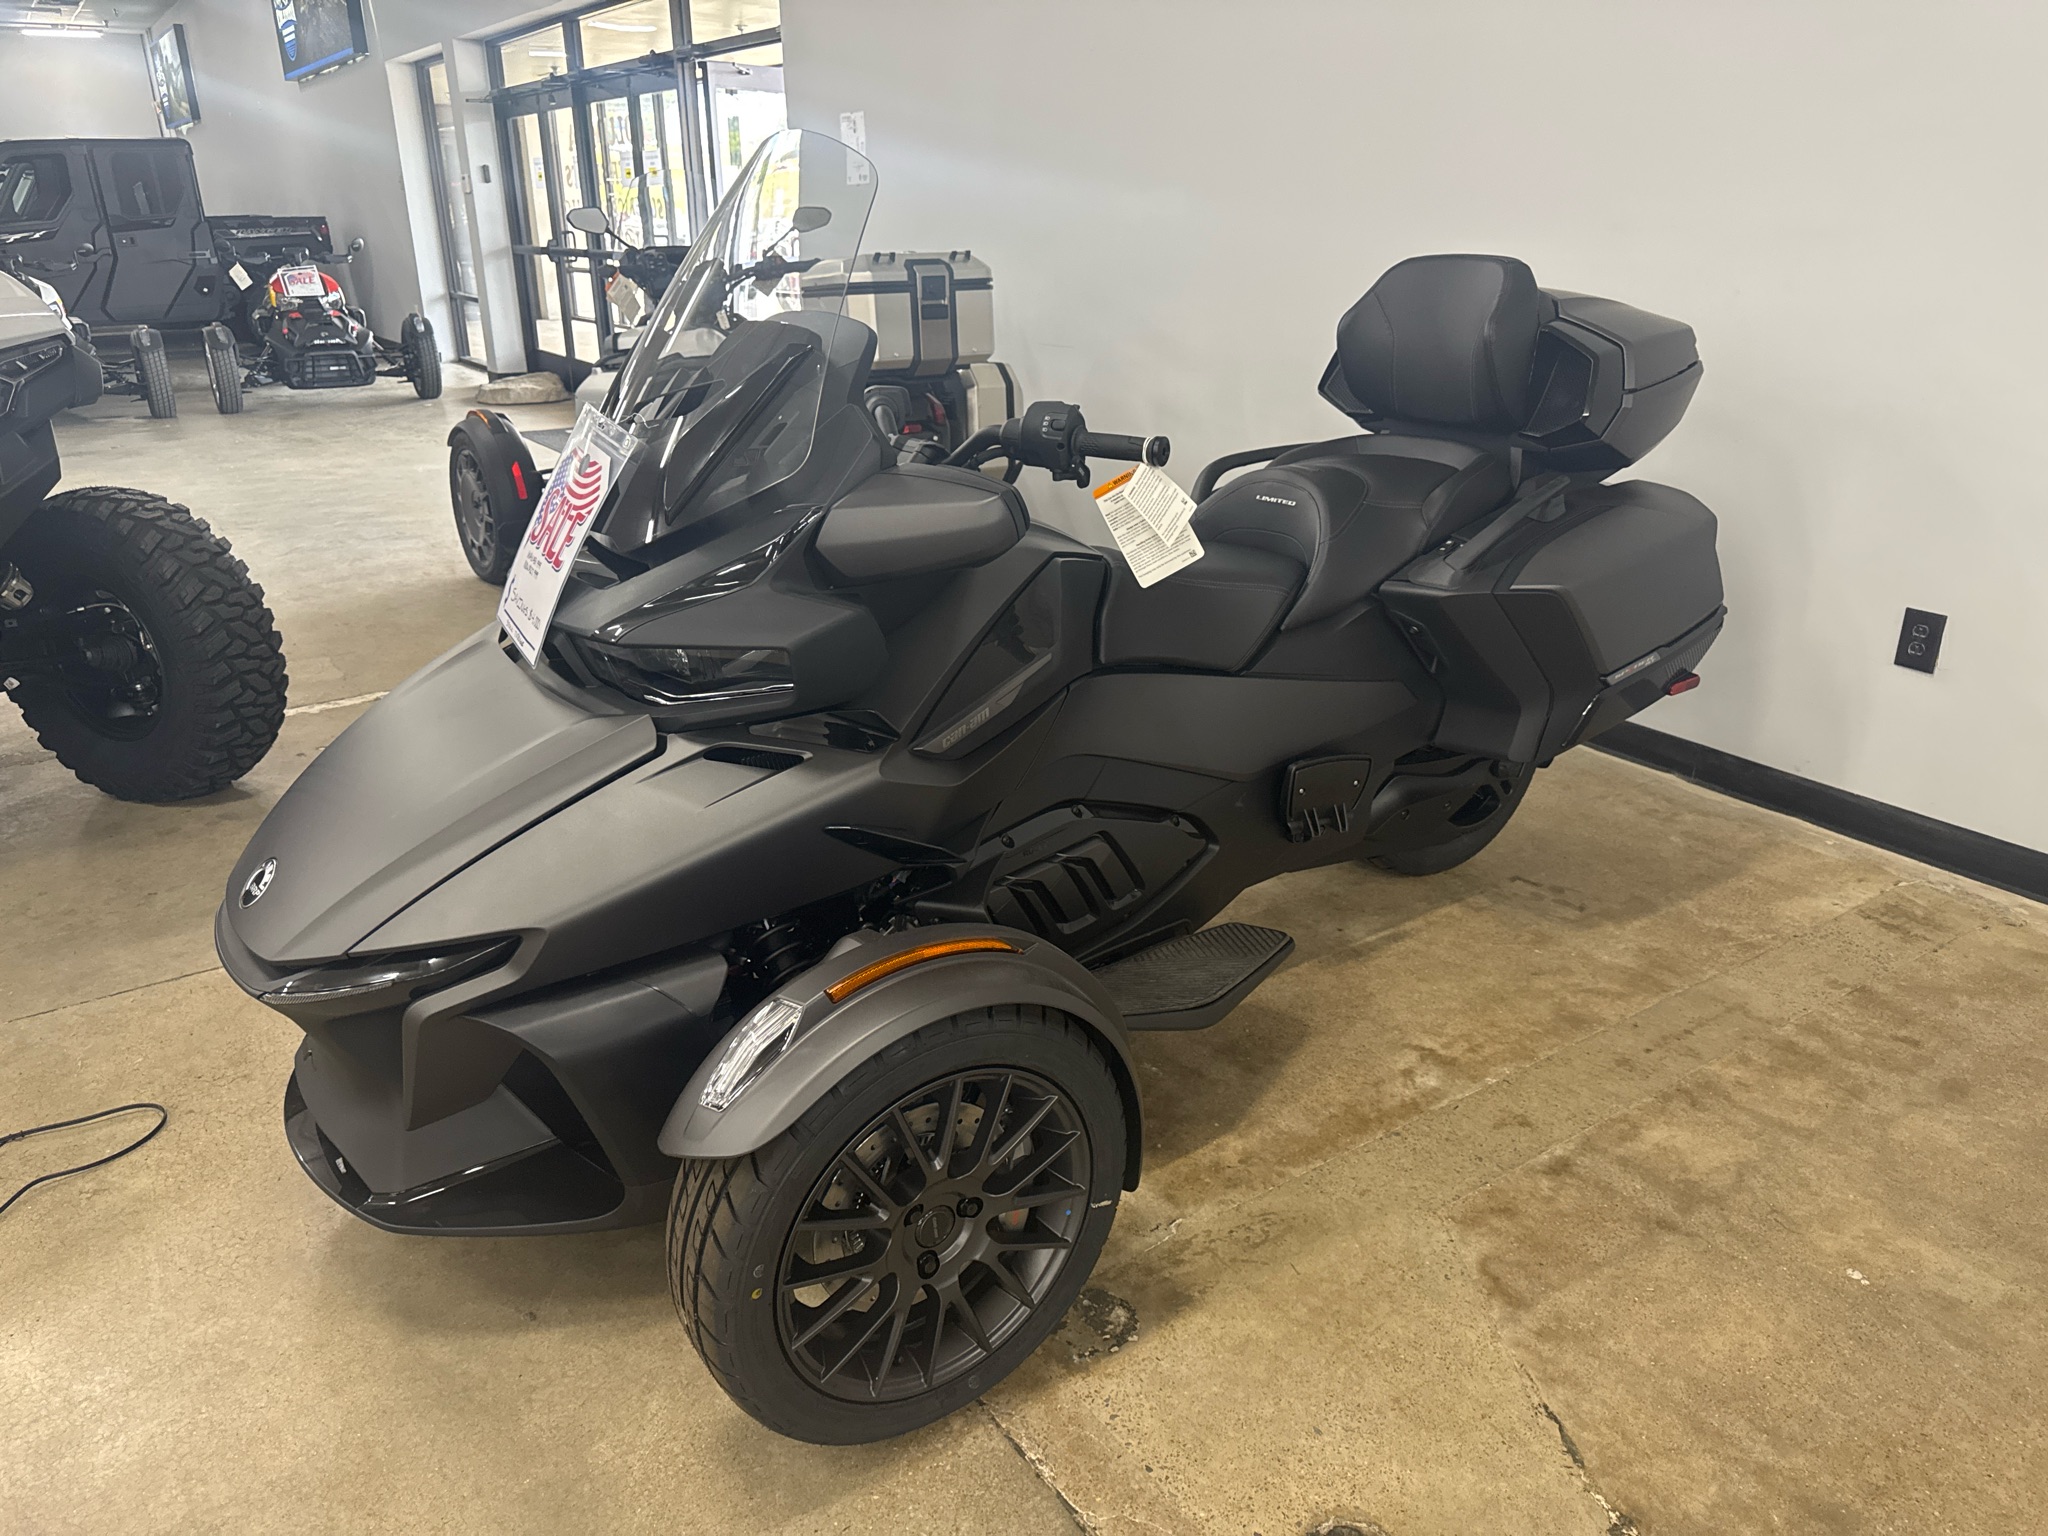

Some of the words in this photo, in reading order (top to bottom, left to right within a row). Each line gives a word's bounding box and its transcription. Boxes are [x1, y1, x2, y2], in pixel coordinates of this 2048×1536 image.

[1255, 494, 1297, 506] LIMITED
[530, 488, 586, 571] SALE
[942, 707, 990, 749] can-am
